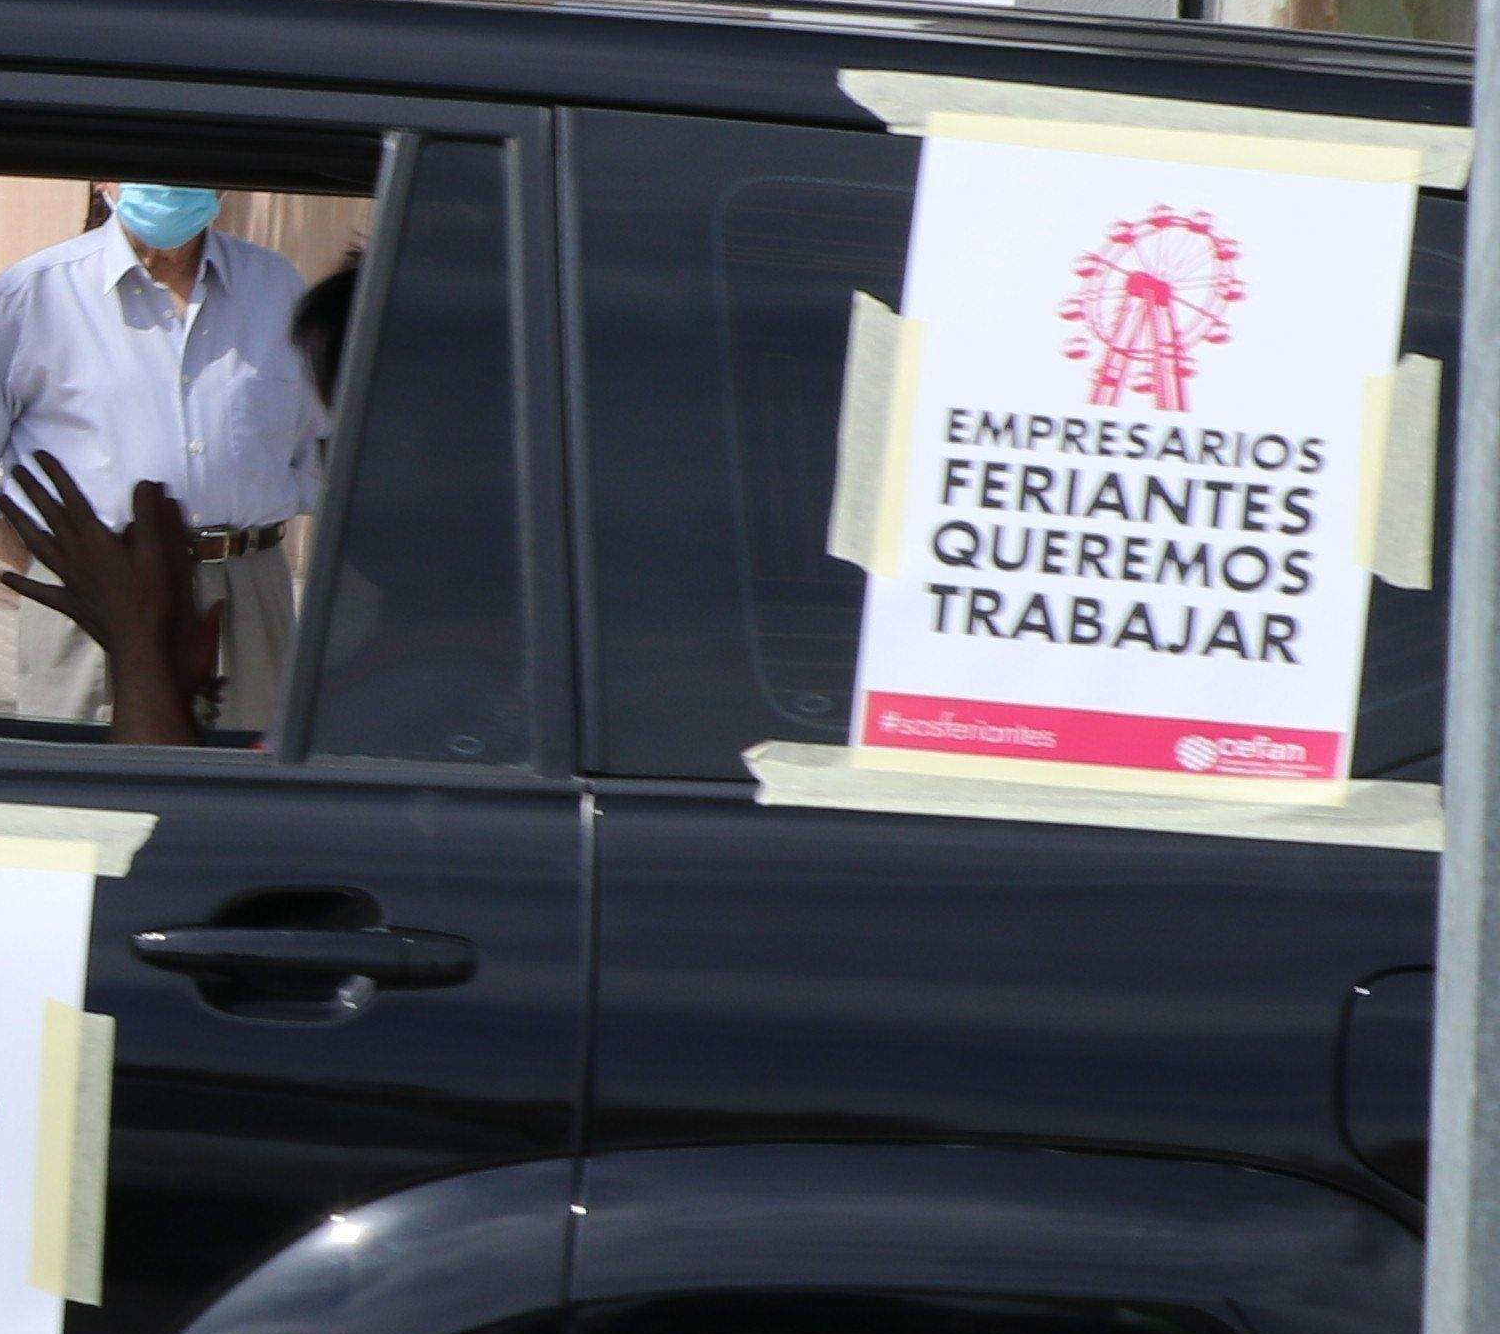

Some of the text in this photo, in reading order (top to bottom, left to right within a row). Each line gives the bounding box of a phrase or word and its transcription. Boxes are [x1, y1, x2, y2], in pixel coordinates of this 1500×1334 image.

[944, 407, 1330, 475] EMPRESARIOS
[939, 458, 1320, 535] FERIANTES
[930, 520, 1318, 597] QUEREMOS
[925, 581, 1303, 667] TRABAJAR
